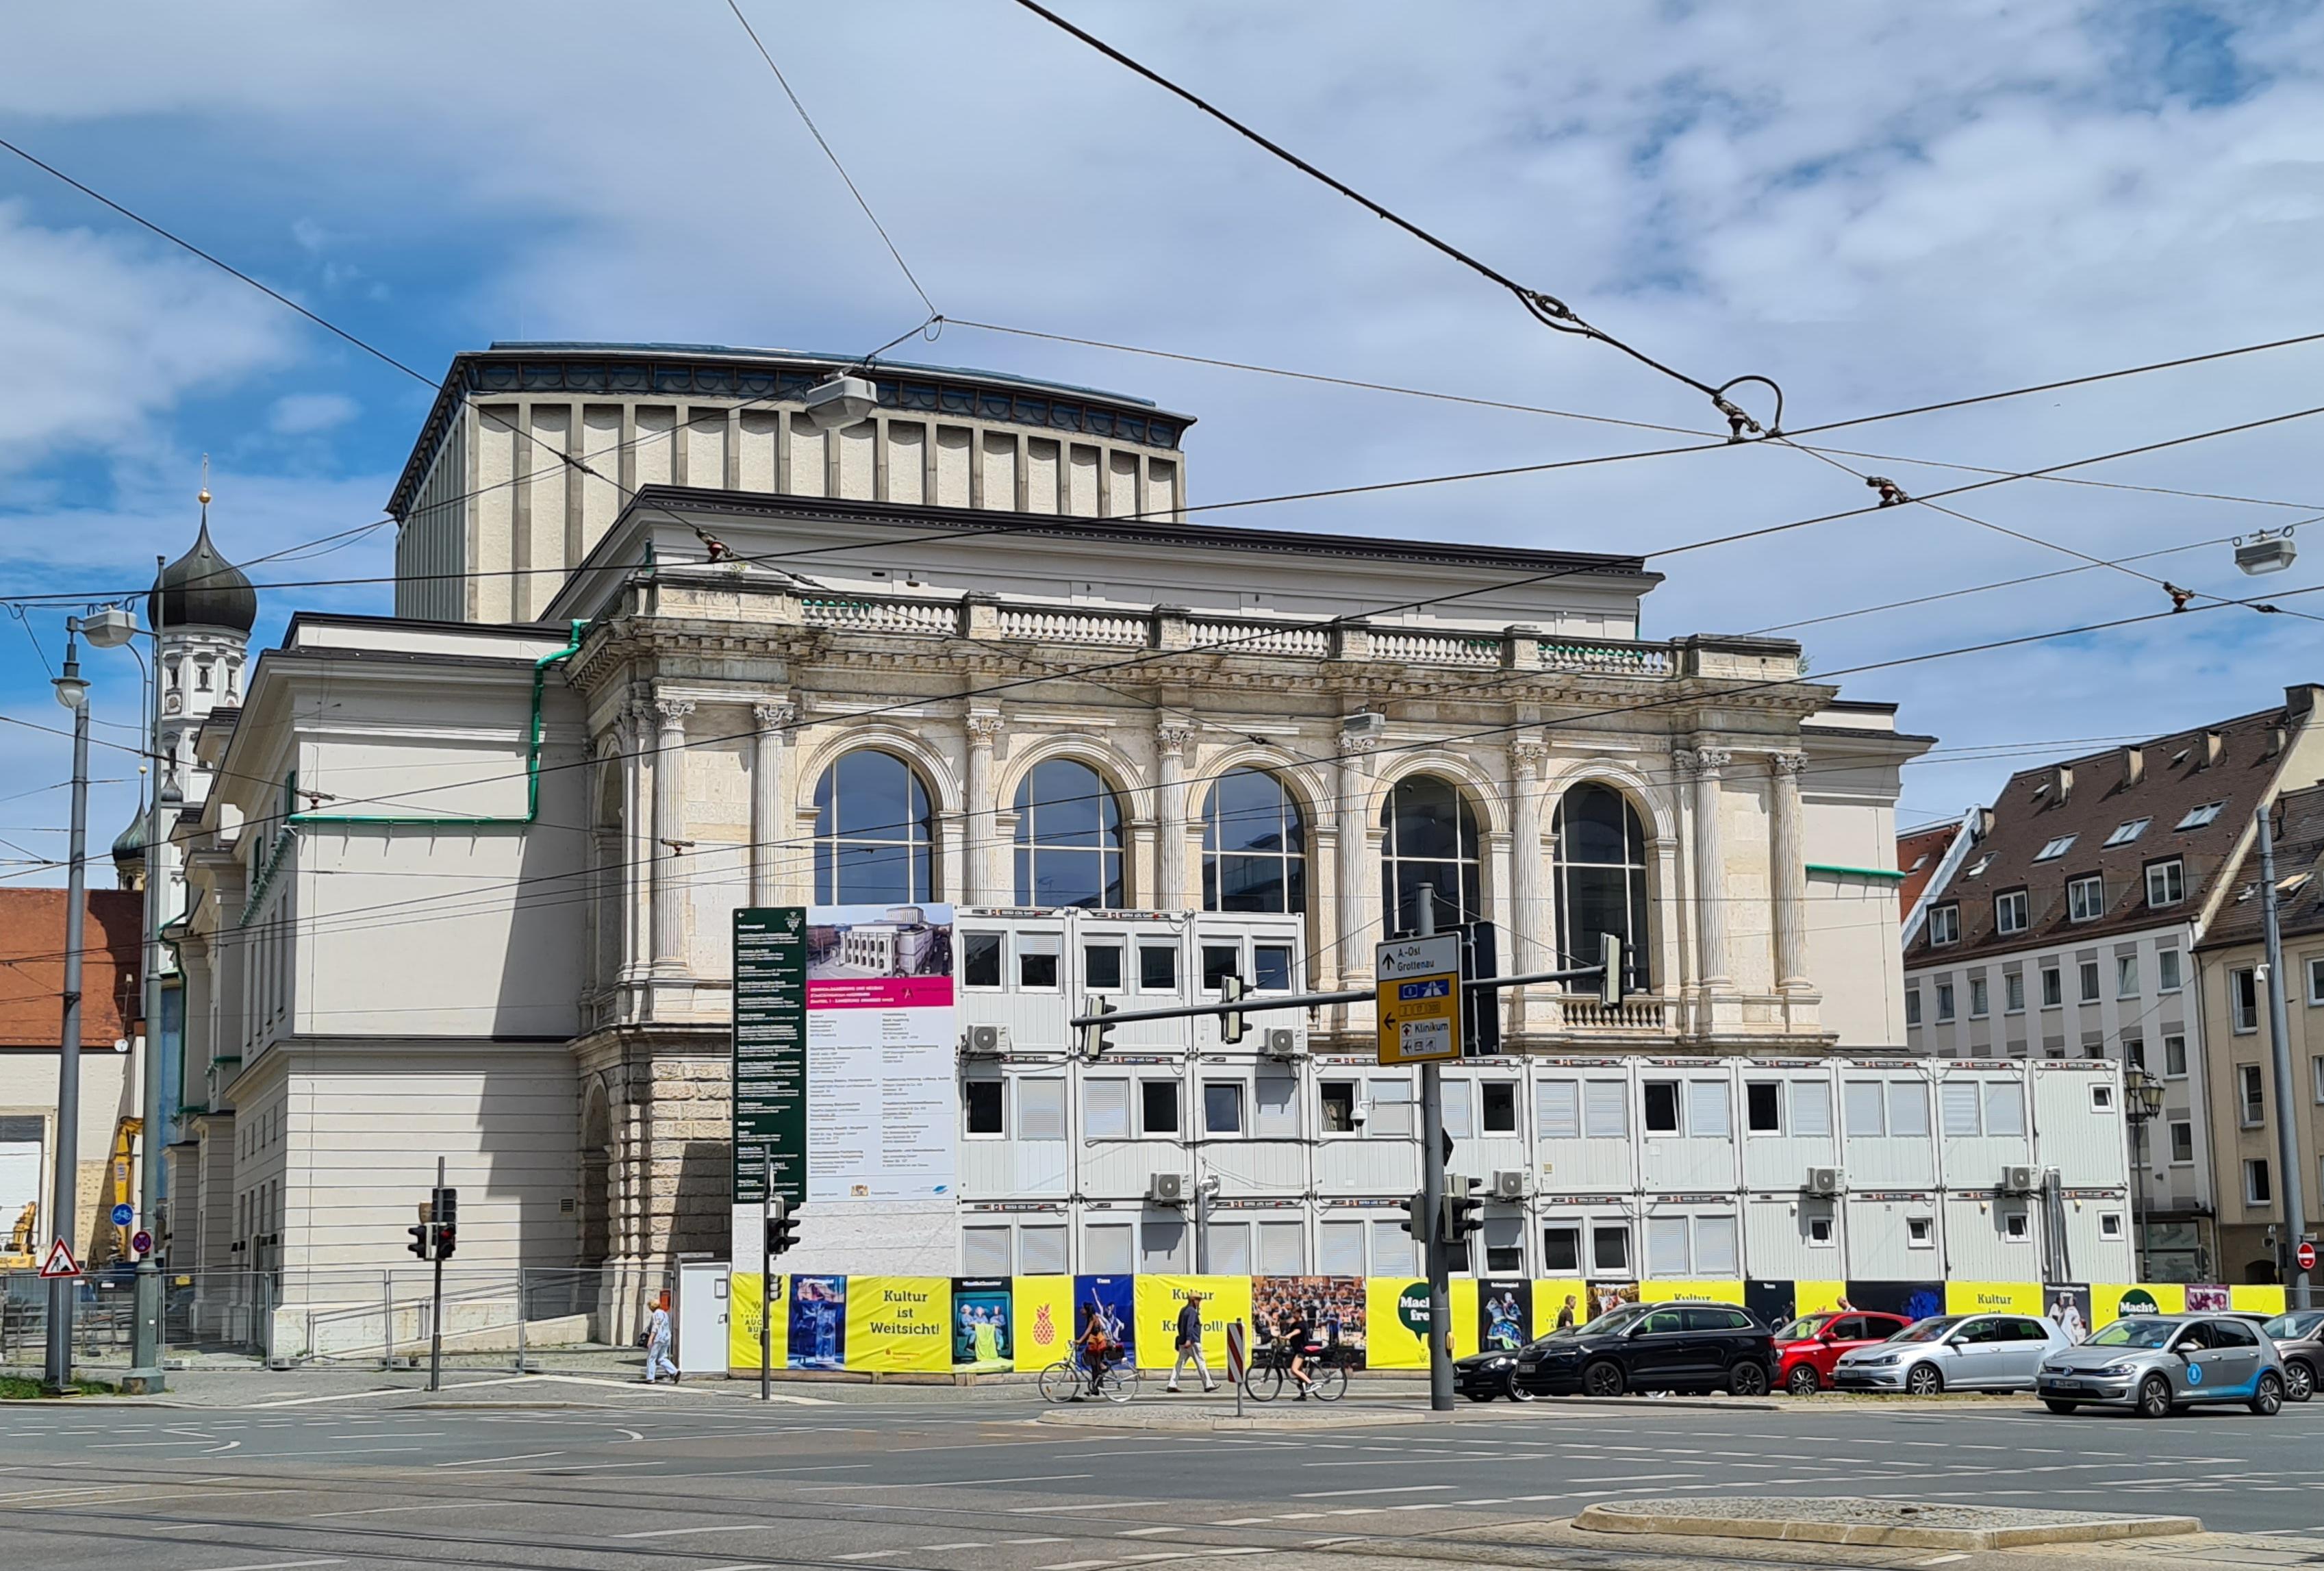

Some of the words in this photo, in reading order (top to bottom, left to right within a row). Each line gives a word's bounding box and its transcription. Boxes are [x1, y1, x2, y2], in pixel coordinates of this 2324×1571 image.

[1398, 946, 1421, 958] A.-Ost
[1398, 960, 1435, 971] Grottenau
[1415, 1022, 1449, 1033] Klinikum
[883, 1290, 929, 1303] Kultur
[1172, 1288, 1215, 1300] Kuur
[1978, 1293, 2012, 1305] Kultur
[897, 1307, 913, 1318] ist
[870, 1322, 939, 1335] Weitsicht!
[1162, 1320, 1223, 1332] Kroll!
